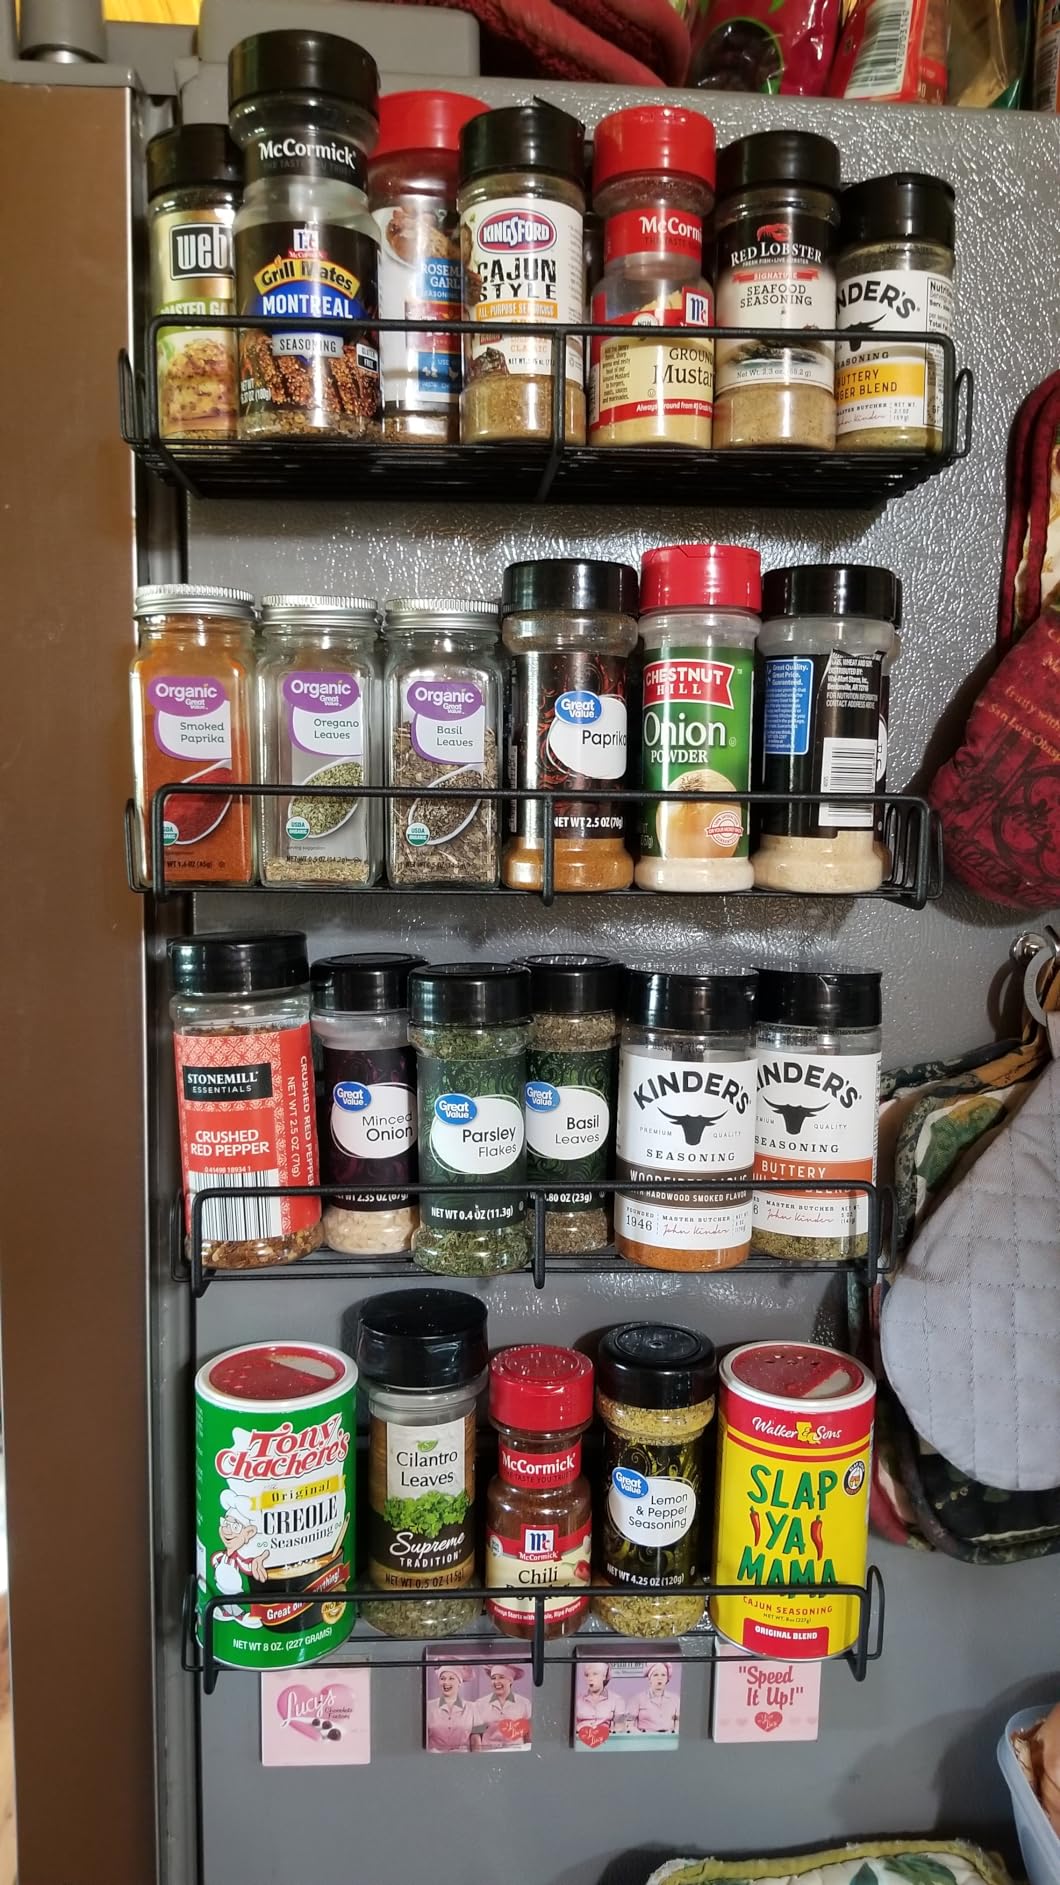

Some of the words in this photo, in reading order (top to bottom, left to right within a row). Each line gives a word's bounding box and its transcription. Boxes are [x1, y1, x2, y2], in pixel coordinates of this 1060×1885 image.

[258, 138, 356, 170] McCormick
[483, 216, 550, 248] KINGSFORD
[176, 226, 234, 271] web
[731, 246, 758, 267] RED
[760, 241, 822, 263] LOBSTER
[261, 259, 296, 287] Grill
[302, 260, 353, 292] Mates
[477, 257, 557, 284] CAJUN
[479, 283, 557, 302] STYLE
[746, 284, 806, 302] SEAFOOD
[262, 294, 353, 319] MONTREAL
[740, 295, 813, 308] SEASONING
[279, 338, 337, 354] SEASOING
[859, 382, 898, 395] BLEND
[646, 667, 724, 686] CHESTNUT
[155, 683, 218, 702] Organic
[291, 679, 352, 699] Organic
[415, 687, 475, 706] Organic
[657, 683, 702, 695] HILL
[560, 699, 595, 711] Great
[569, 708, 595, 719] Value
[180, 722, 225, 731] Smoked
[313, 718, 360, 729] Oregano
[437, 726, 463, 735] Basil
[644, 711, 726, 747] Onion
[180, 734, 225, 745] Paprika
[314, 730, 351, 740] Leaves
[436, 737, 474, 747] Leaves
[650, 750, 709, 763] POWDER
[570, 816, 585, 828] WT
[586, 817, 600, 828] 2.5
[600, 816, 610, 828] OZ
[187, 1071, 257, 1085] STONEMILL
[300, 1055, 310, 1113] CRUSHED
[757, 1061, 858, 1109] INDER'S
[192, 1085, 252, 1094] ESSENTIALS
[288, 1076, 297, 1097] NET
[336, 1087, 364, 1100] Great
[526, 1087, 553, 1100] Great
[633, 1070, 749, 1115] KINDER'S
[288, 1099, 298, 1117] WT
[343, 1097, 365, 1106] Value
[438, 1100, 470, 1112] Great
[532, 1097, 553, 1106] Value
[362, 1112, 413, 1126] Minced
[445, 1110, 470, 1119] Value
[566, 1114, 600, 1130] Basil
[303, 1115, 312, 1141] RED
[366, 1126, 413, 1142] Onion
[462, 1126, 517, 1143] Parsley
[639, 1126, 673, 1136] PREMIUM
[712, 1131, 742, 1139] QUALITY
[195, 1129, 260, 1144] CRUSHED
[290, 1137, 299, 1151] OZ
[555, 1133, 600, 1145] Leaves
[755, 1135, 840, 1153] SEASONING
[190, 1144, 213, 1157] RED
[215, 1141, 271, 1157] PEPPER
[478, 1143, 517, 1158] Flakes
[646, 1148, 735, 1162] SEASONING
[761, 1160, 827, 1178] BUTTERY
[560, 1193, 571, 1202] OZ
[572, 1192, 592, 1203] (23g)
[646, 1191, 690, 1202] HARDWOOD
[692, 1194, 724, 1202] SMOKED
[725, 1190, 747, 1201] FLAVOR
[431, 1206, 444, 1218] NET
[445, 1208, 458, 1220] WT
[459, 1210, 473, 1221] 0.4
[474, 1209, 486, 1220] OZ
[486, 1205, 514, 1220] (11.3g)
[626, 1206, 655, 1218] FOUNDED
[766, 1200, 795, 1210] MASTER
[626, 1215, 653, 1231] 1946
[662, 1215, 694, 1223] MASTER
[250, 1413, 342, 1458] Tony
[752, 1416, 797, 1439] Walker
[813, 1425, 842, 1441] Sons
[216, 1430, 350, 1479] Chachere's
[396, 1450, 458, 1468] Cilantro
[502, 1451, 575, 1475] McCormick
[401, 1470, 455, 1487] Leaves
[514, 1473, 535, 1483] TASTE
[536, 1475, 552, 1484] YOU
[615, 1471, 642, 1489] Great
[271, 1480, 331, 1503] Original
[621, 1484, 643, 1495] Value
[747, 1464, 839, 1511] SLAP
[651, 1493, 688, 1506] Lemon
[263, 1496, 338, 1535] CREOLE
[635, 1505, 644, 1517] &
[648, 1505, 688, 1520] Pepper
[628, 1516, 687, 1530] Seasoning
[270, 1525, 334, 1550] Seasoning
[765, 1511, 806, 1555] YA
[389, 1531, 465, 1560] Supreme
[399, 1553, 459, 1568] TRADITION
[519, 1550, 559, 1561] McCormick
[518, 1566, 558, 1585] Chili
[607, 1562, 618, 1575] NET
[618, 1569, 631, 1582] WT
[631, 1575, 649, 1586] 4.25
[649, 1577, 660, 1587] OZ
[661, 1573, 685, 1587] (120g)
[736, 1546, 839, 1599] MAMA
[384, 1573, 398, 1587] NET
[401, 1576, 413, 1588] WT
[415, 1577, 430, 1589] 0.5
[432, 1576, 444, 1587] OZ
[266, 1606, 292, 1621] Great
[743, 1596, 772, 1612] CAJUN
[776, 1605, 833, 1617] SEASONING
[233, 1638, 248, 1650] NET
[249, 1641, 262, 1651] WT
[263, 1643, 269, 1651] 8
[271, 1641, 284, 1651] OZ.
[285, 1640, 303, 1651] (227
[304, 1627, 333, 1646] GRAMS)
[754, 1625, 792, 1640] ORIGINAL
[792, 1632, 818, 1640] BLEND
[739, 1664, 794, 1689] "Speed
[747, 1687, 760, 1706] It
[766, 1686, 804, 1711] Up!"
